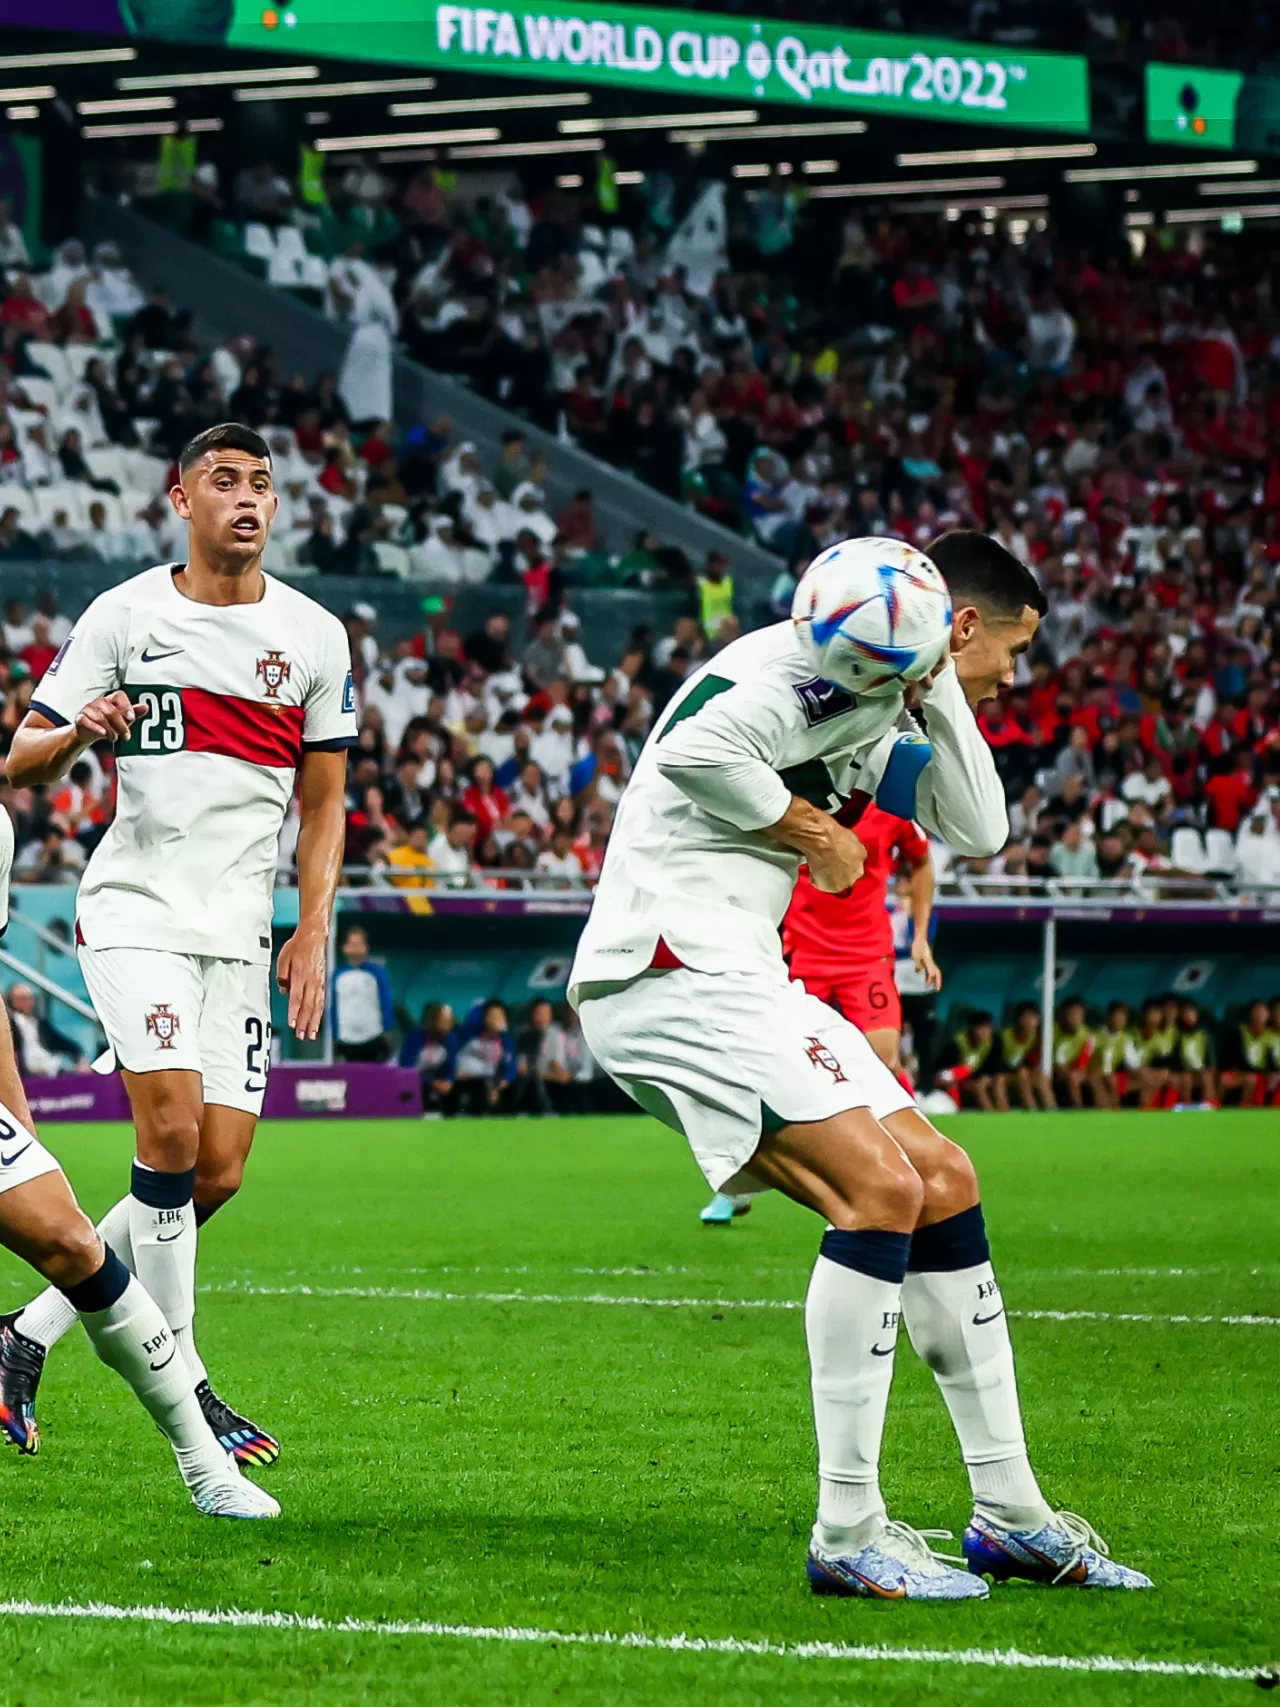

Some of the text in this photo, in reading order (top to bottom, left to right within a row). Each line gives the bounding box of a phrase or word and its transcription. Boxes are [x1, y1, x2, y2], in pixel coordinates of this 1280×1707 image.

[436, 5, 521, 58] FIFA
[524, 14, 662, 72] WORLD
[670, 30, 740, 80] CUP
[138, 691, 185, 750] 23
[868, 981, 889, 1010] 6
